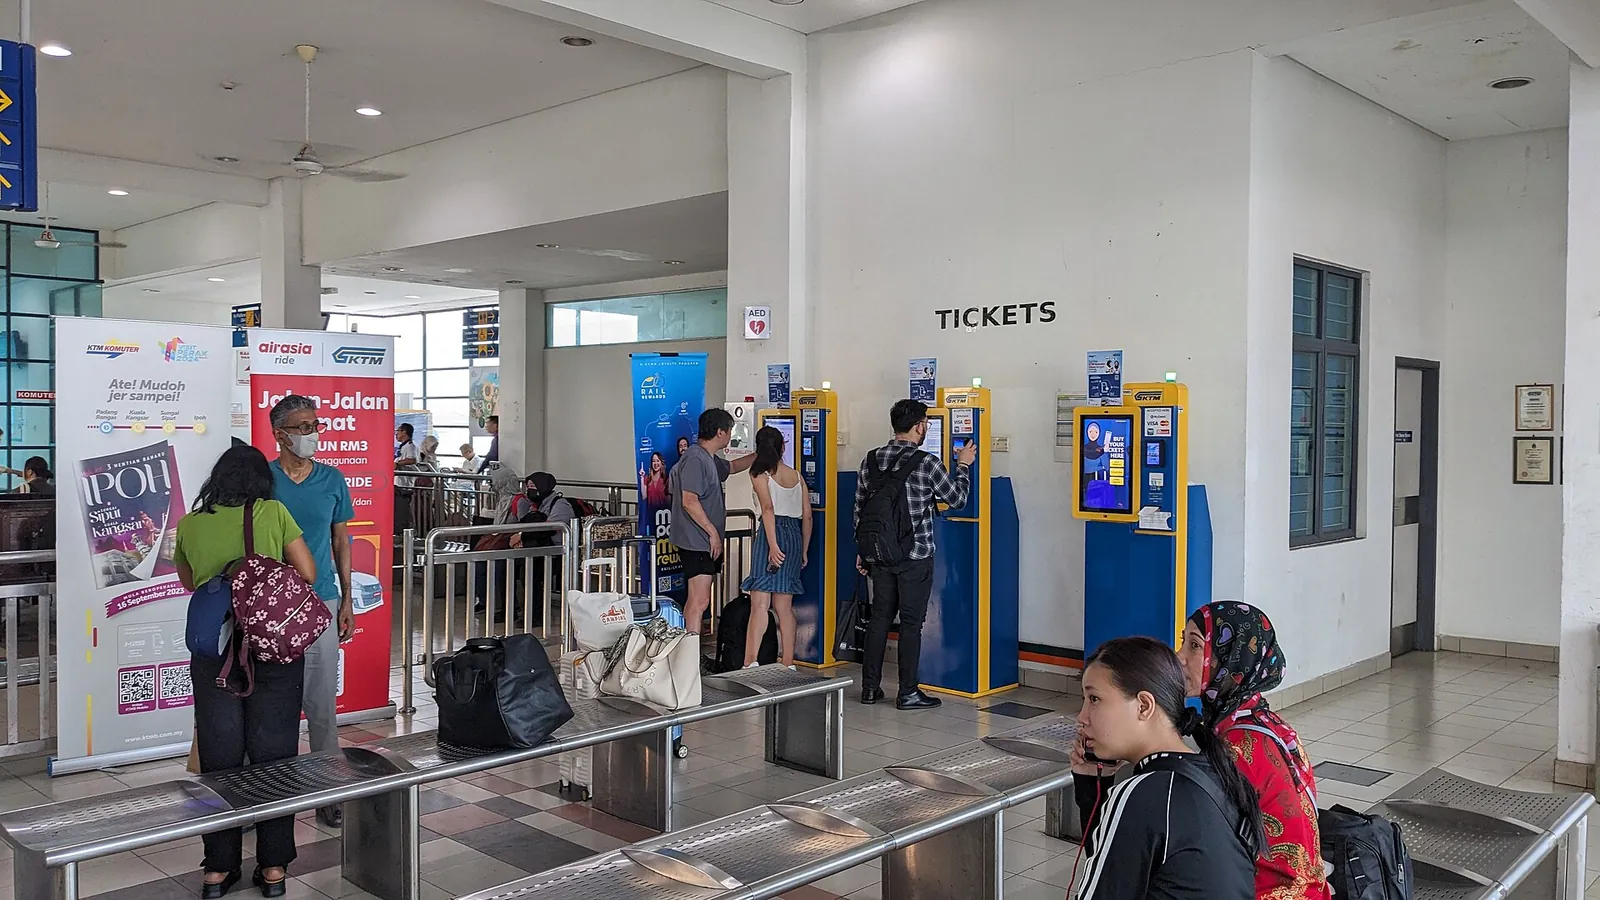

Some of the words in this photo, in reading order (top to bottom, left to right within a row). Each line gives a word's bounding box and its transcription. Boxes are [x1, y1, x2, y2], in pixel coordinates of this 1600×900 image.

[934, 301, 1056, 330] TICKETS
[258, 342, 312, 355] airasia
[275, 356, 295, 364] ride
[348, 356, 384, 365] KTM
[109, 379, 137, 390] Ate!
[140, 380, 186, 391] Mudoh
[107, 390, 128, 402] jer
[130, 392, 181, 403] sampei!
[258, 390, 389, 410] Jan-Jalan
[340, 441, 368, 452] RM3
[345, 477, 372, 487] RIDE
[117, 601, 127, 610] 16
[127, 591, 166, 605] September
[167, 587, 185, 596] 2023
